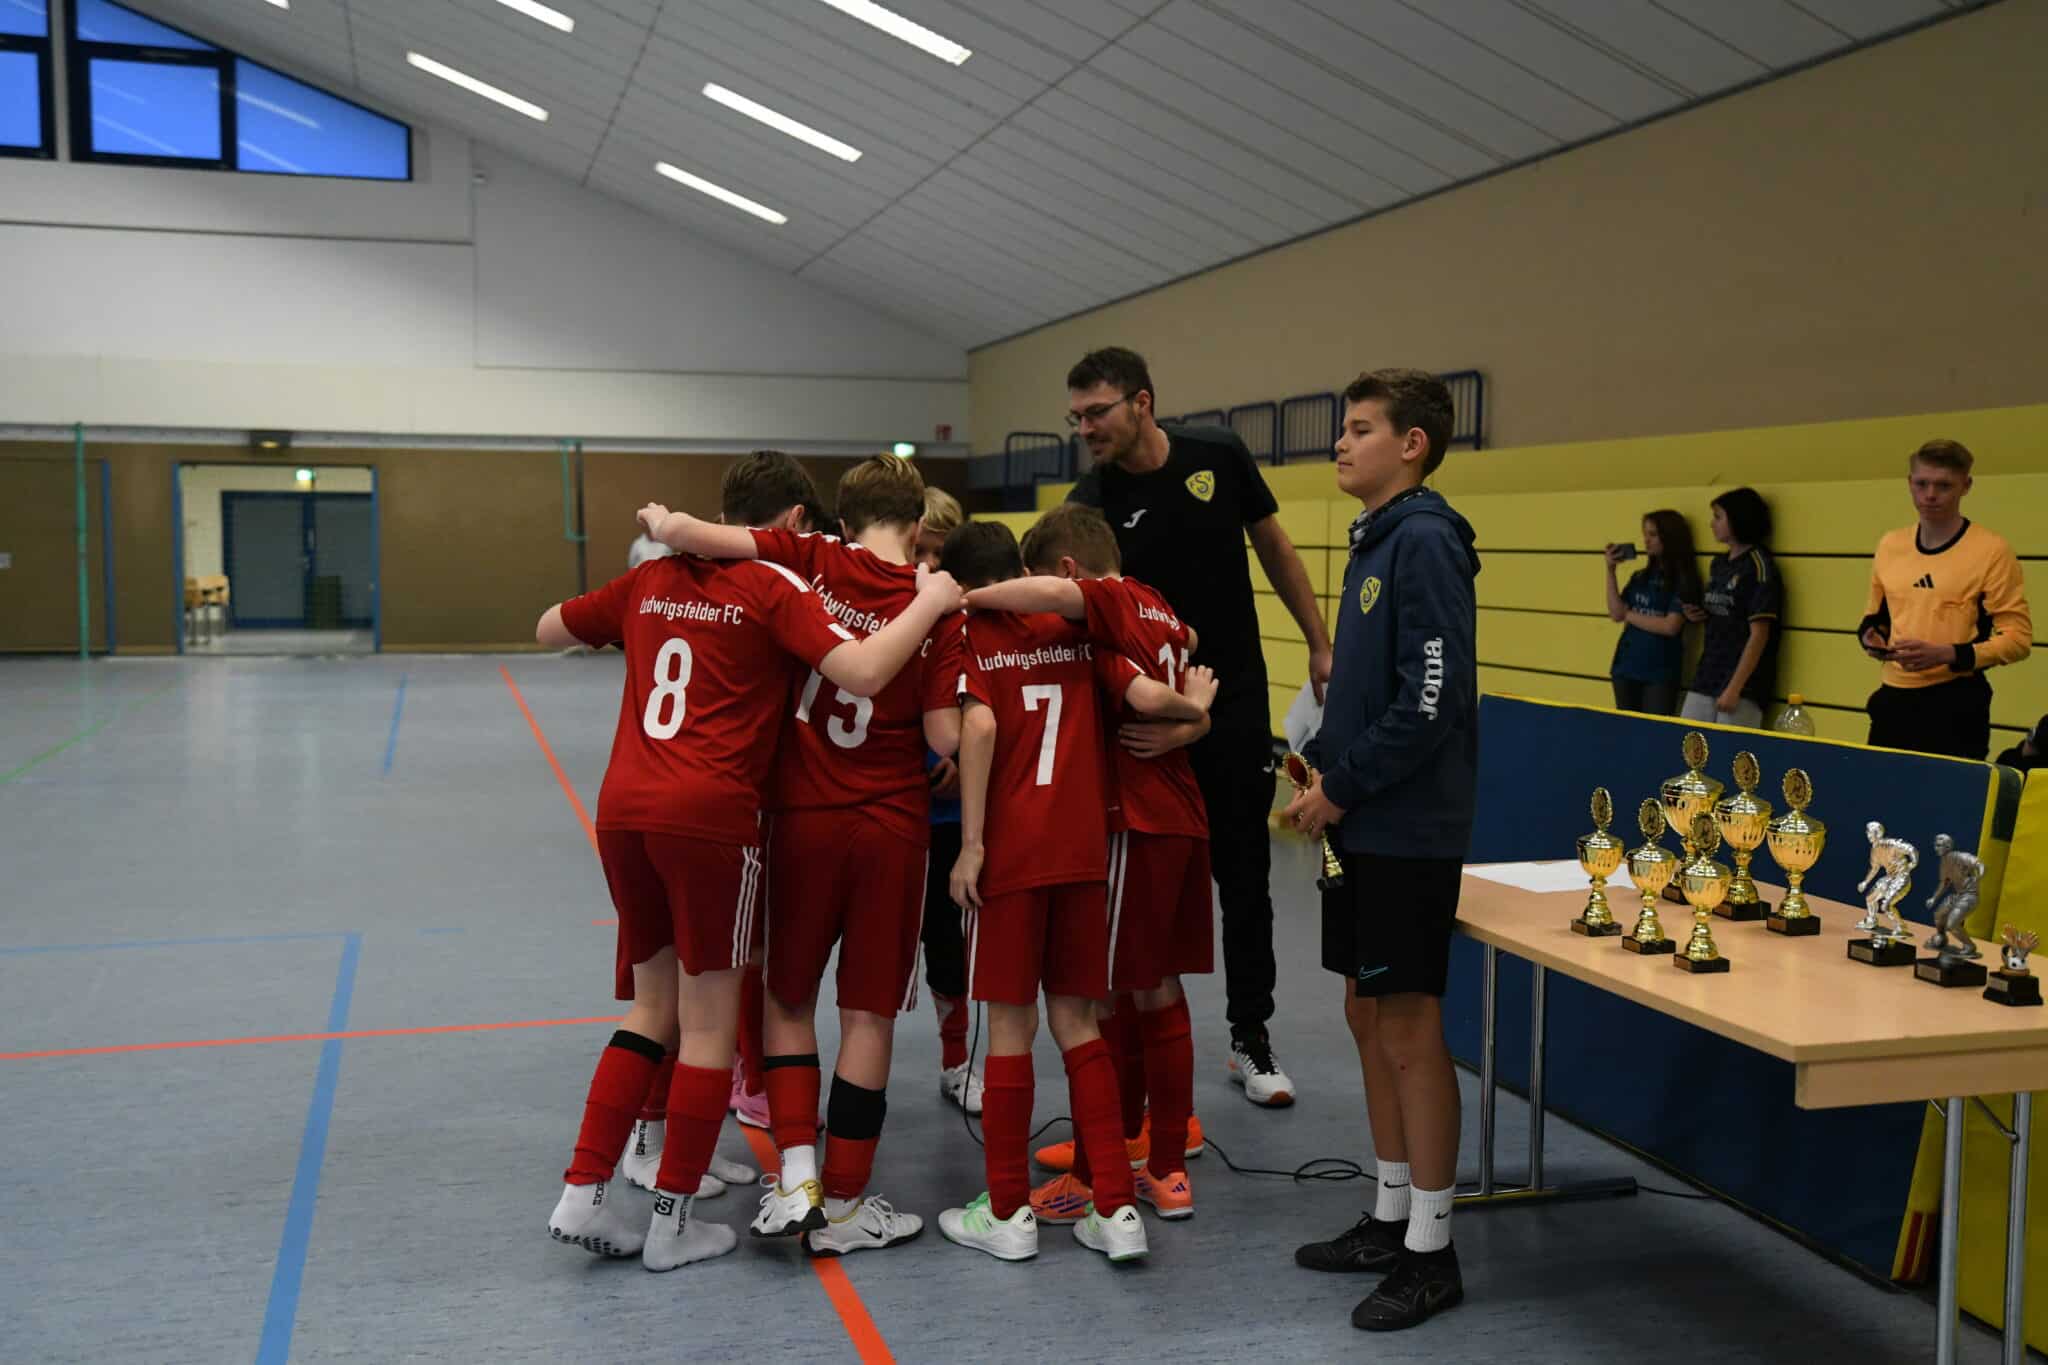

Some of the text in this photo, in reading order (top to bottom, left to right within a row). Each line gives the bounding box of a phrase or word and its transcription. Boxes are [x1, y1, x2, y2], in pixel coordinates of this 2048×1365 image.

[639, 595, 744, 625] Ludwigsfelder FC
[643, 637, 693, 740] 8
[976, 643, 1094, 671] Ludwigsfelder FC
[1021, 683, 1063, 786] 7
